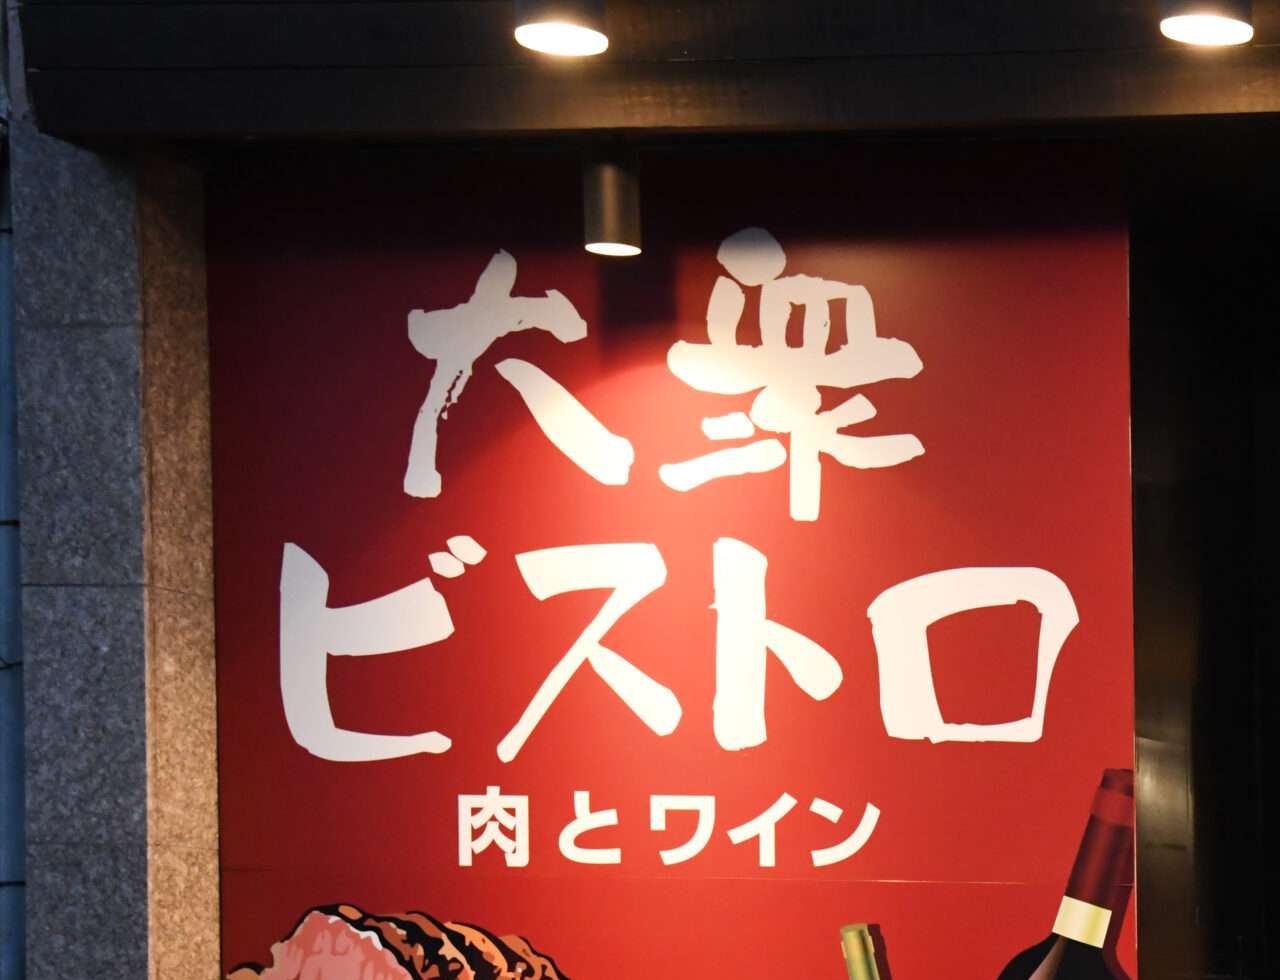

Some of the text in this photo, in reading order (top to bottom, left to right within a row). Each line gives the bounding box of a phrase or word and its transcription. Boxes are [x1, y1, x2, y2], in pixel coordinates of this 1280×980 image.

[404, 227, 925, 521] 大衆
[280, 536, 1080, 763] ビストロ
